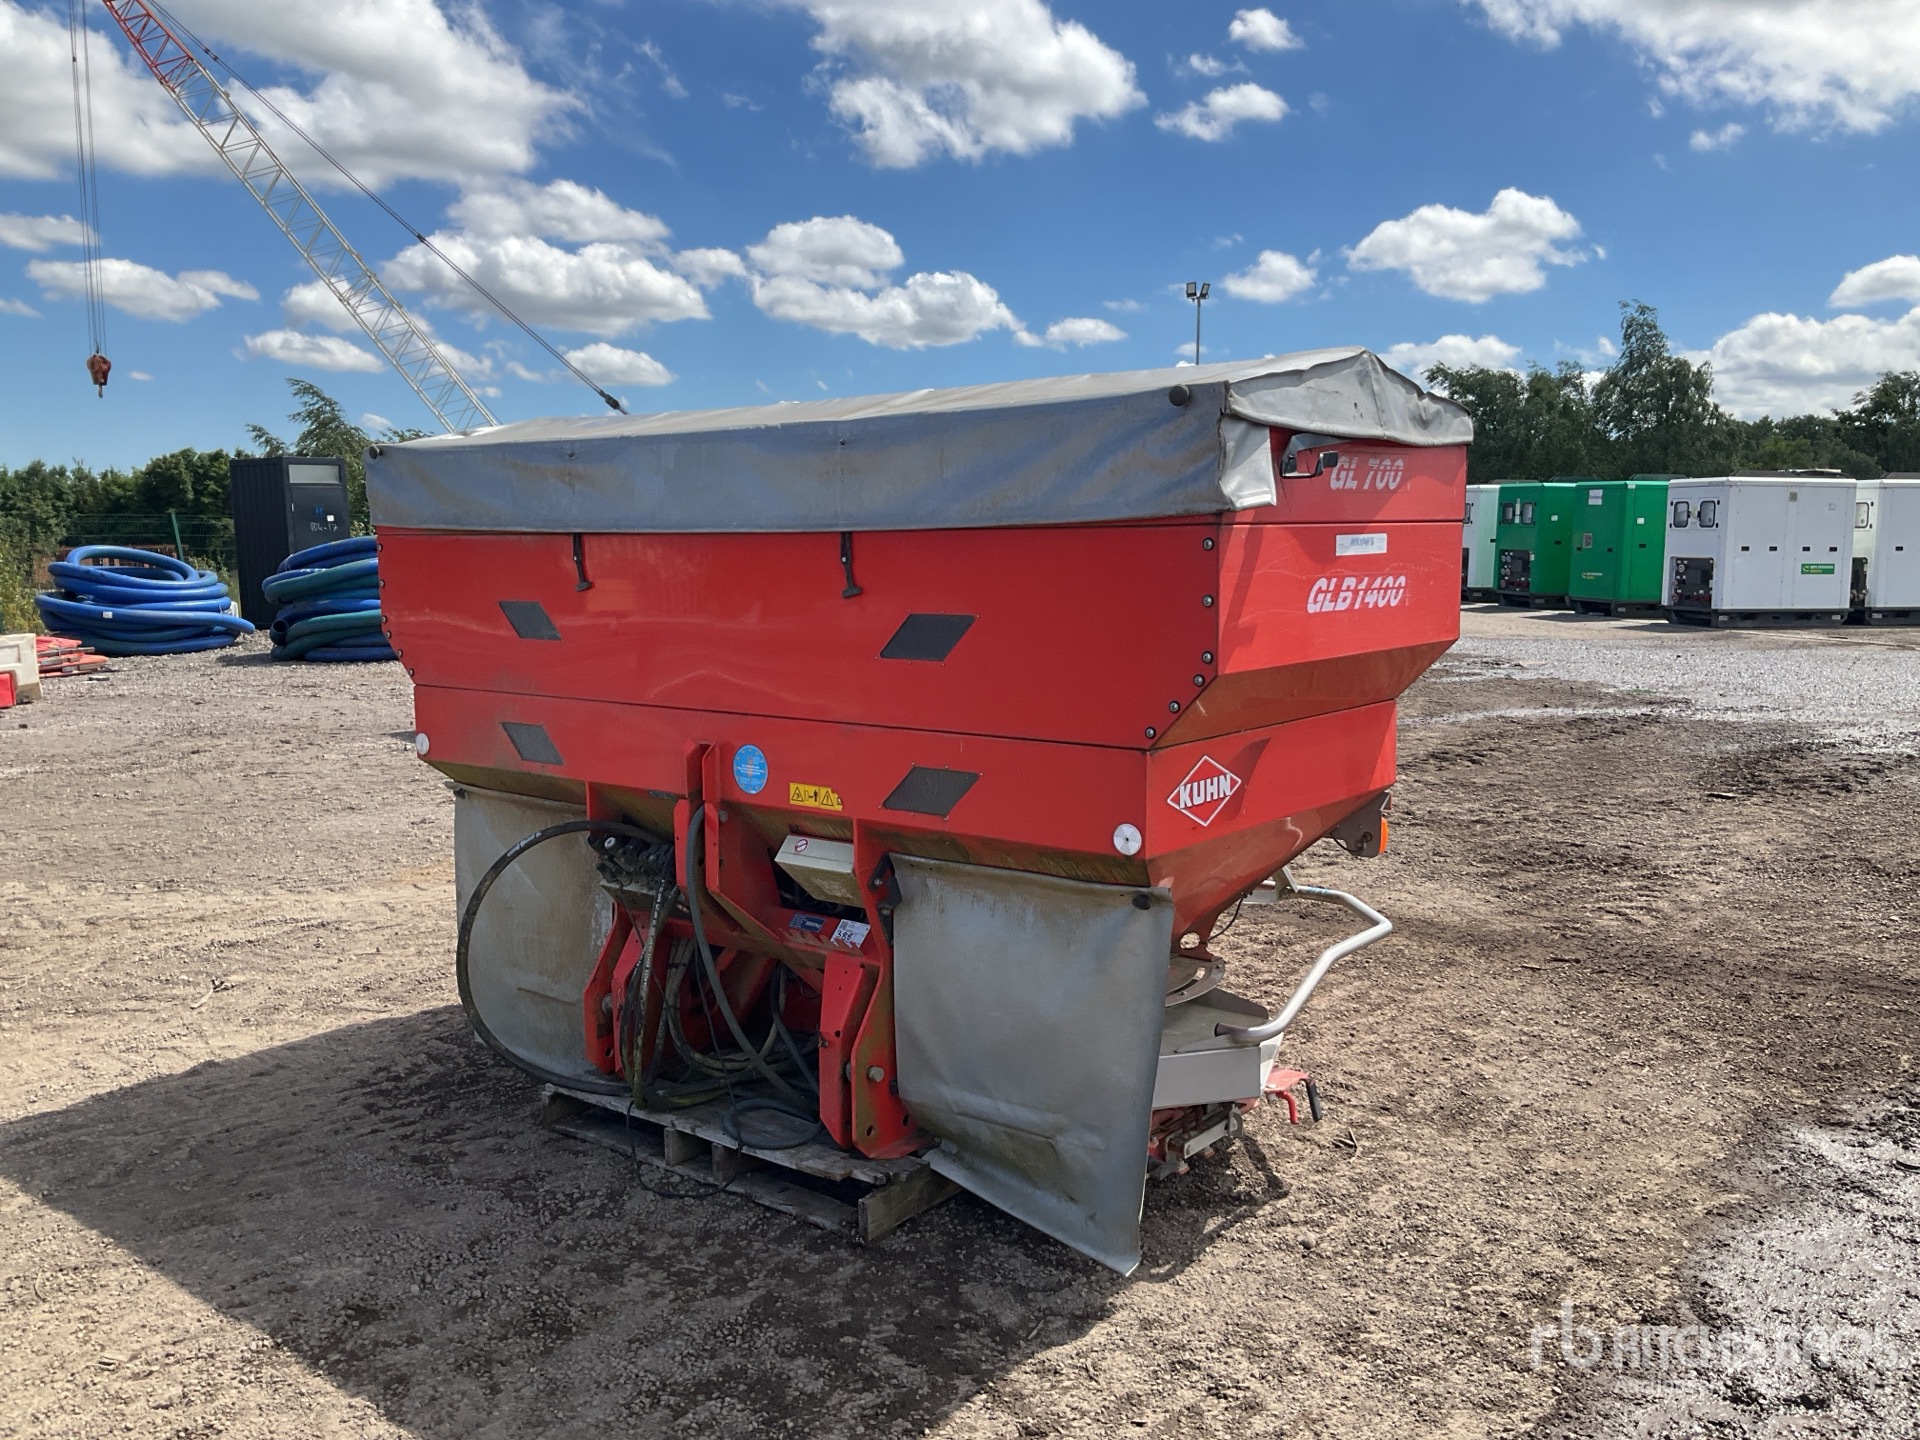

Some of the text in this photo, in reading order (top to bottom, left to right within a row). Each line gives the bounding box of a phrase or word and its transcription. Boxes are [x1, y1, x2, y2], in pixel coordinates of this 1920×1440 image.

[1330, 456, 1404, 490] GL 700
[1306, 575, 1406, 613] GLB1400
[1179, 773, 1231, 809] KUHN
